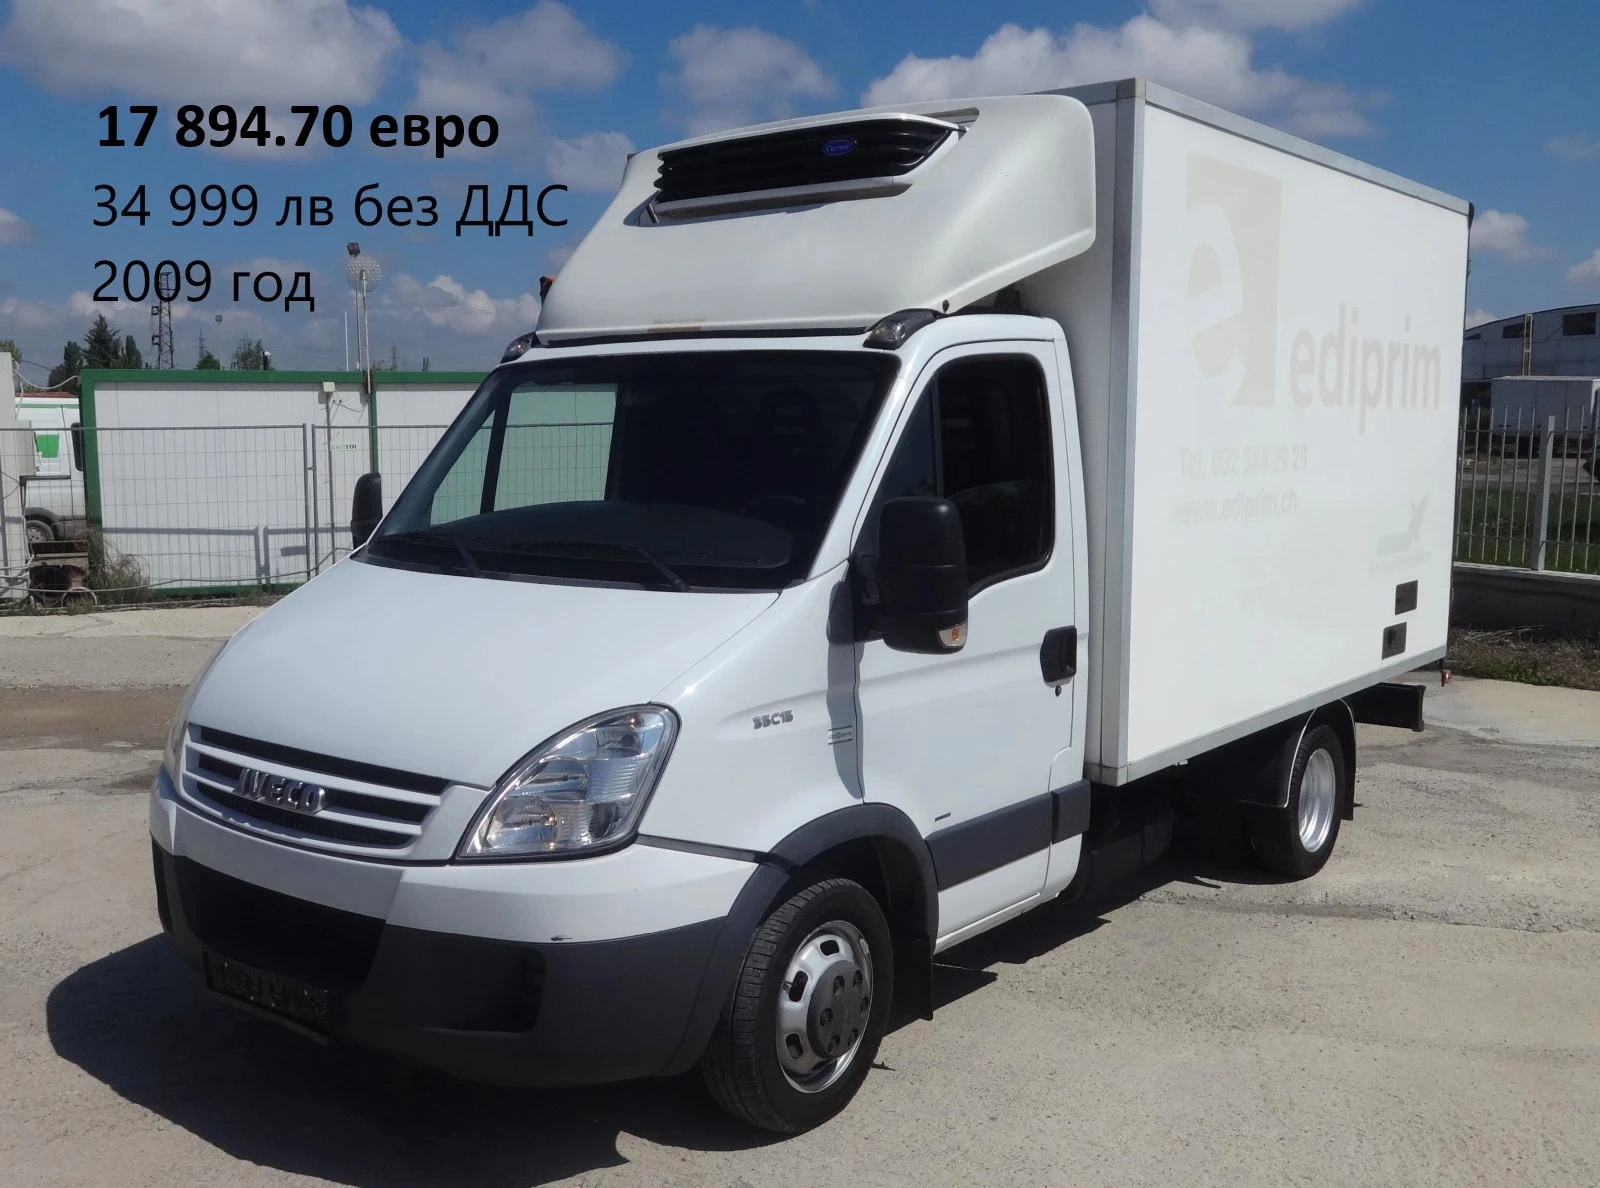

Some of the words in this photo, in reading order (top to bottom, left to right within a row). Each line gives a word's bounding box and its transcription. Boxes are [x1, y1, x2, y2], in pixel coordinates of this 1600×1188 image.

[1289, 302, 1441, 434] ediprim
[752, 709, 794, 730] 55C15
[238, 767, 325, 814] IVECO
